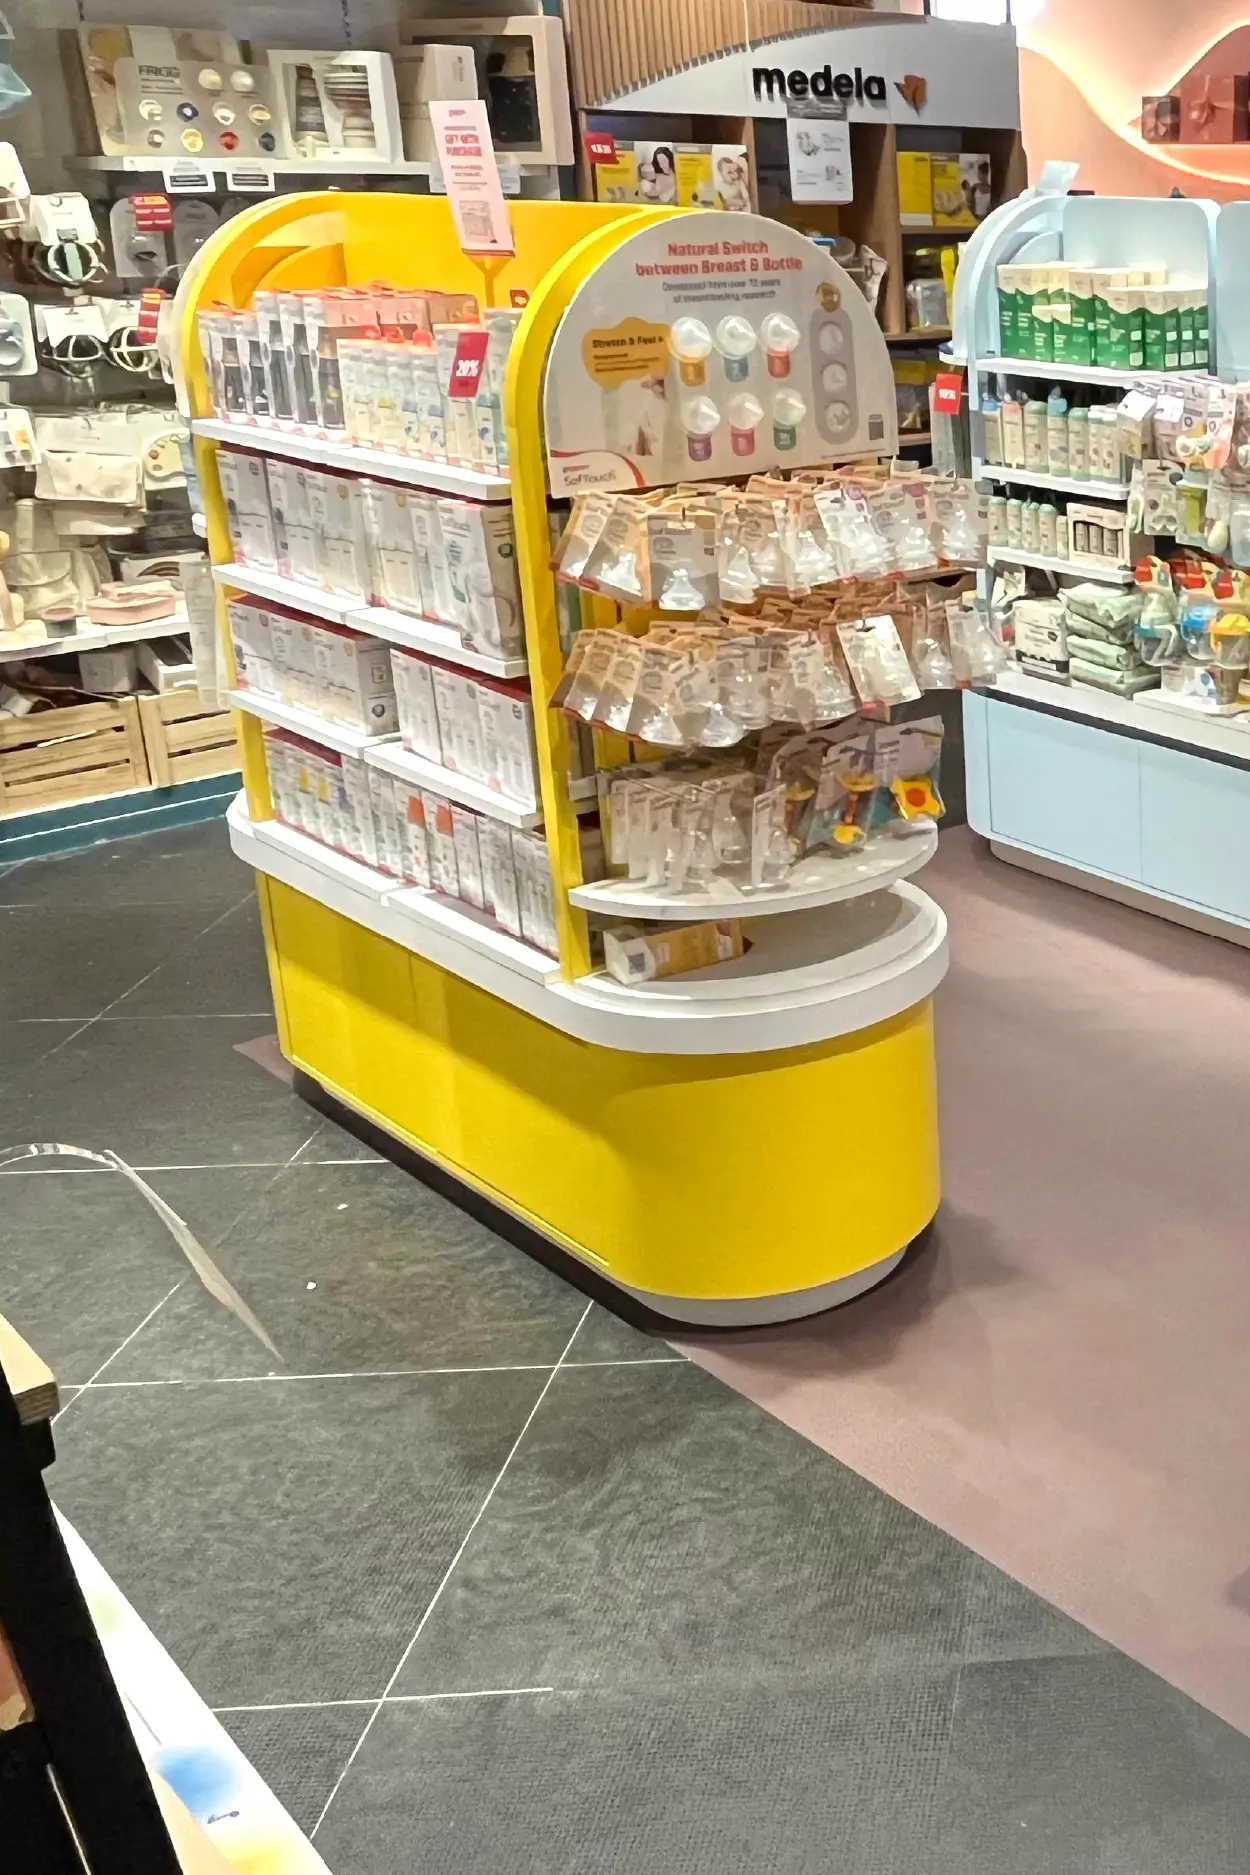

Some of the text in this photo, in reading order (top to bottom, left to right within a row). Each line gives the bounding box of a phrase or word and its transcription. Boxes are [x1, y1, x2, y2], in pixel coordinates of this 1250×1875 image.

[752, 65, 886, 101] medela
[668, 239, 768, 257] Natural Switch
[636, 262, 698, 277] between
[702, 258, 746, 274] Breast
[763, 256, 802, 271] Bottle
